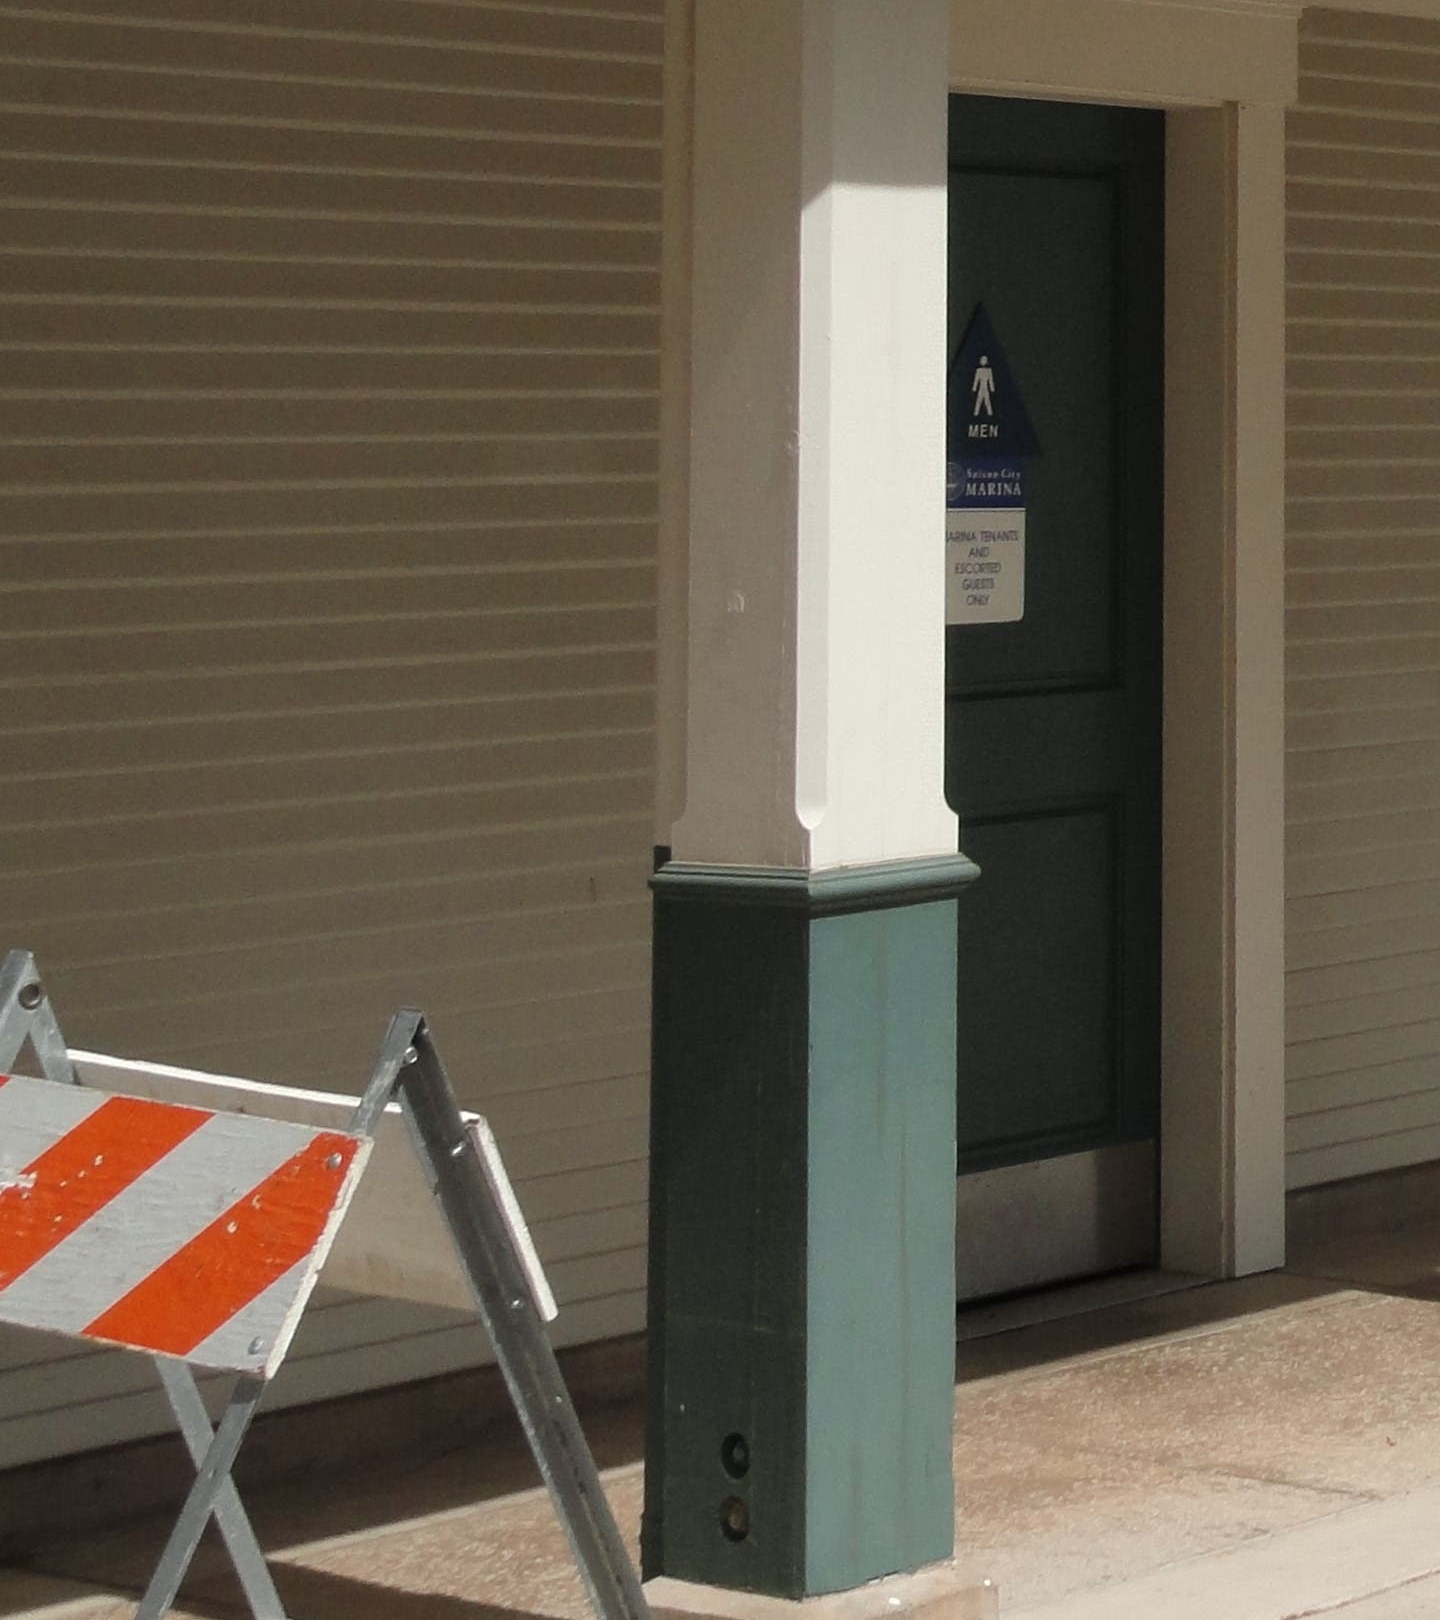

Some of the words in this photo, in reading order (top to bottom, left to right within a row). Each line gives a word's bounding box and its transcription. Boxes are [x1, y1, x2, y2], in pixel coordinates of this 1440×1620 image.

[968, 424, 999, 438] MEN
[1001, 467, 1021, 481] City
[965, 482, 1022, 497] MARINA
[980, 530, 1019, 541] TENANTS
[968, 547, 990, 558] AND
[955, 562, 1002, 574] ESCORTED
[961, 578, 995, 591] GUESTS
[965, 594, 990, 607] ONLY
